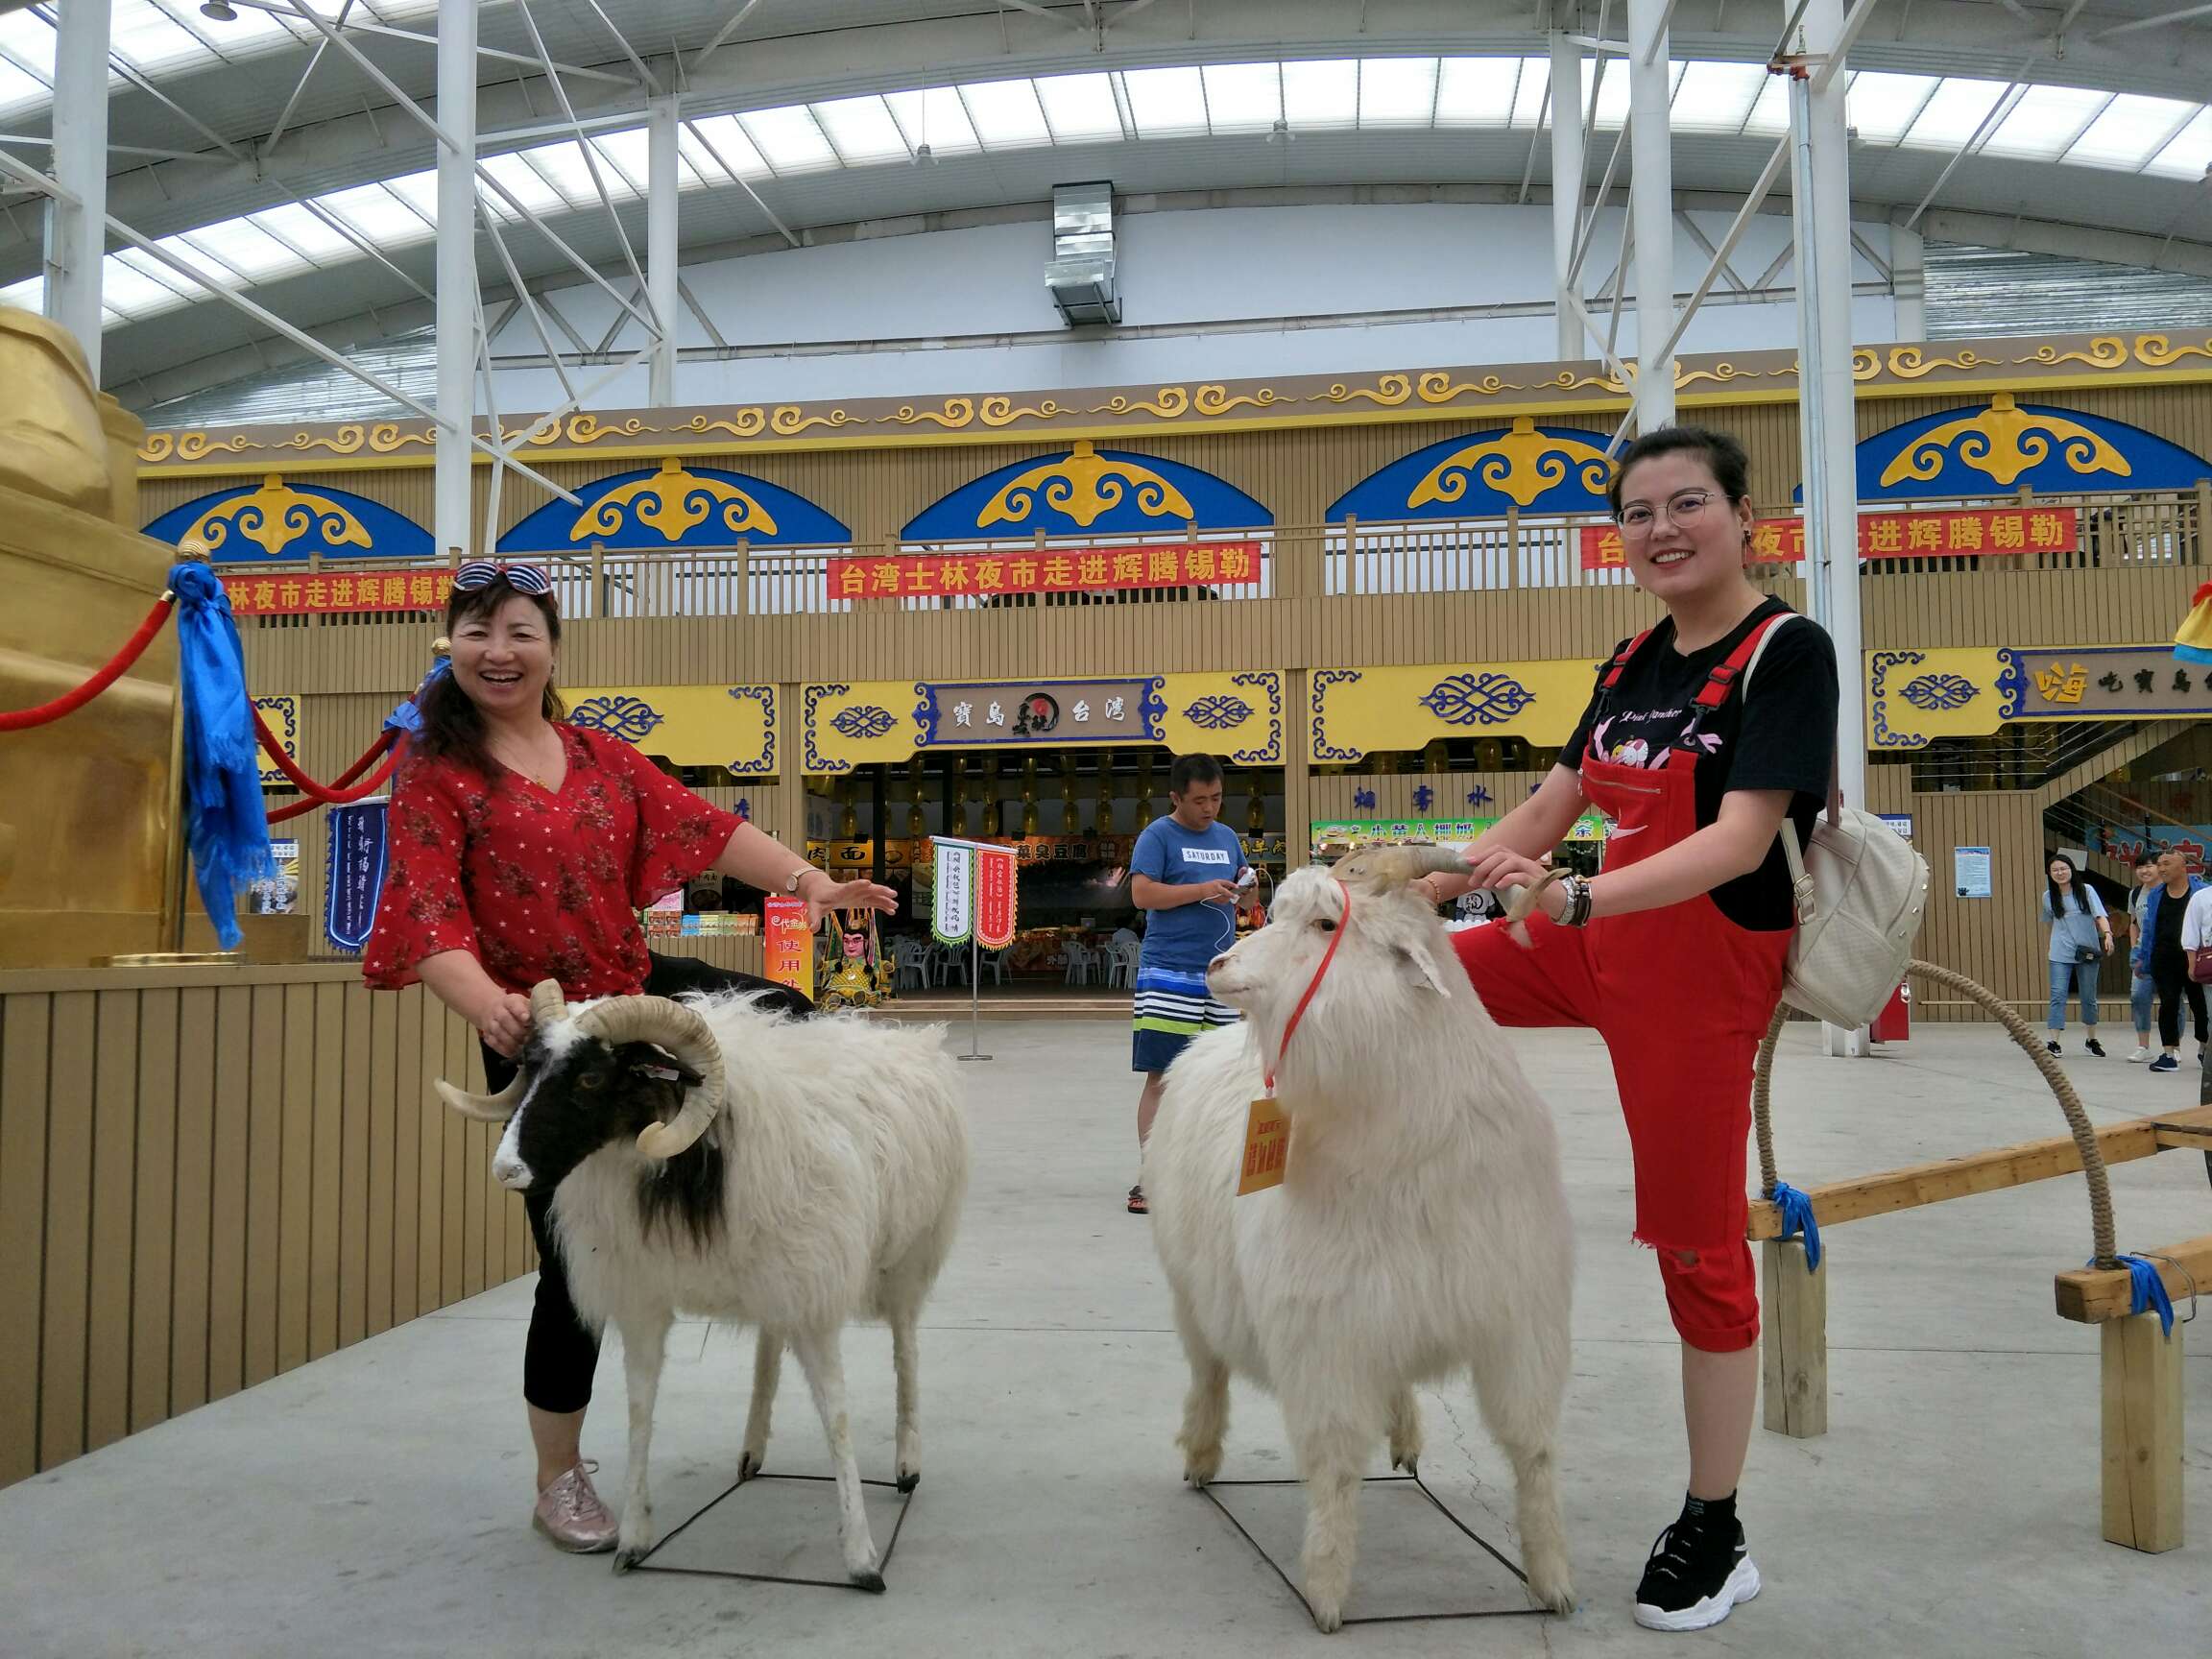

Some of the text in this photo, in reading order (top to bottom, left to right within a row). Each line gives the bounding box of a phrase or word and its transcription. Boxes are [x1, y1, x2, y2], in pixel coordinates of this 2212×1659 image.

[1859, 514, 2065, 553] 进辉腾锡勒
[839, 548, 1250, 594] 台湾士林夜市走进辉腾锡勒
[1186, 851, 1225, 861] SATURDAY
